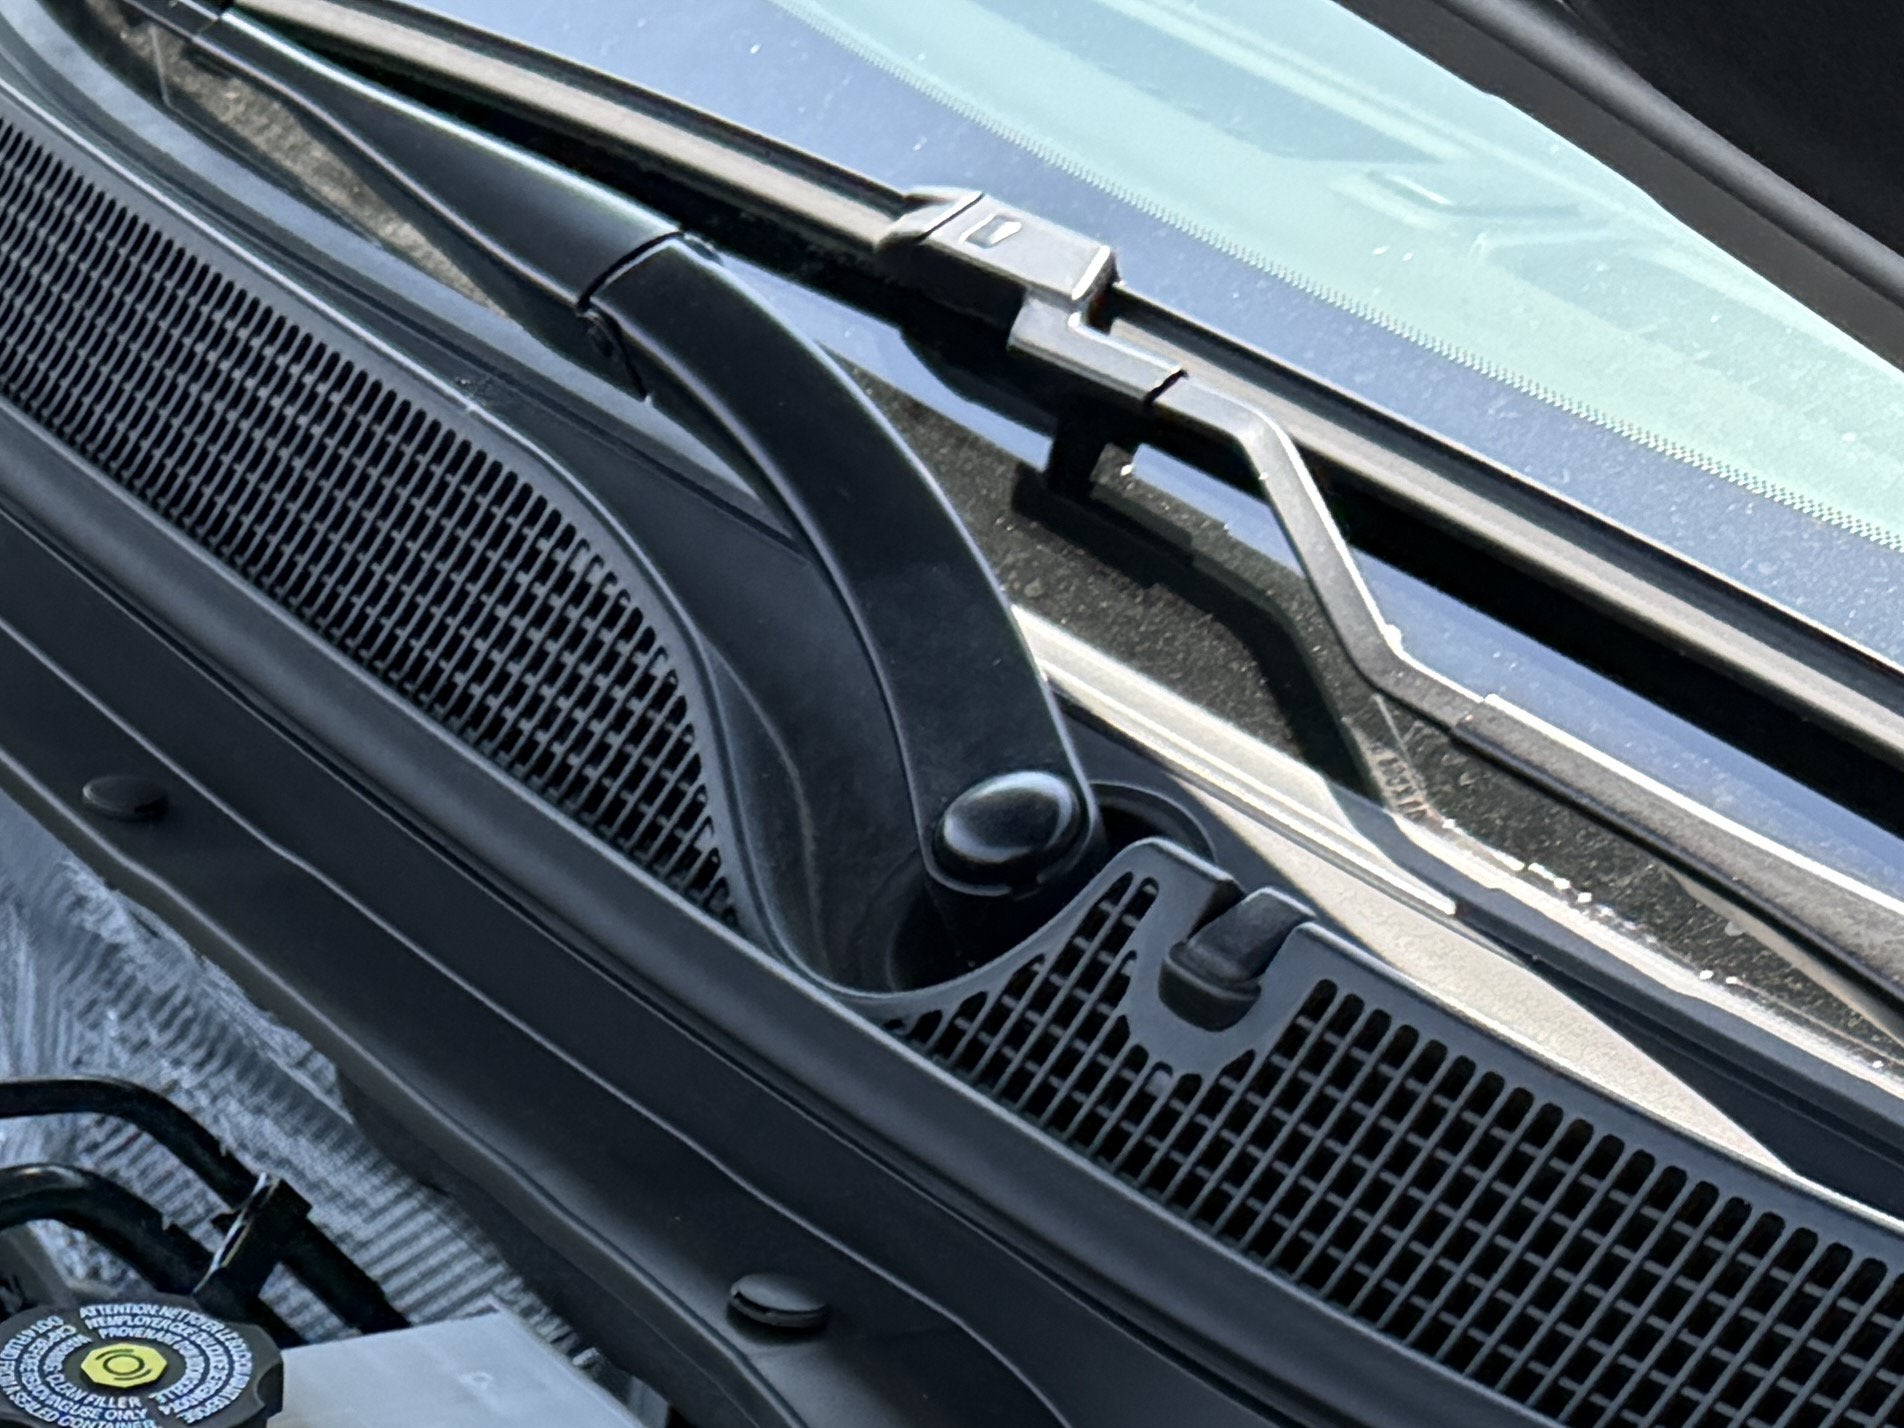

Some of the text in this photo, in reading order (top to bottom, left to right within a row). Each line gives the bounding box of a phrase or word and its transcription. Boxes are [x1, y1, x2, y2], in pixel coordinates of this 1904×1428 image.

[34, 1315, 64, 1333] DOT
[169, 1321, 196, 1337] QUE
[0, 1333, 31, 1359] FLUID
[46, 1373, 86, 1400] CLEAN
[82, 1394, 142, 1409] FILLER
[9, 1391, 60, 1422] SEALED
[68, 1404, 103, 1420] USE
[103, 1408, 149, 1422] ONLY
